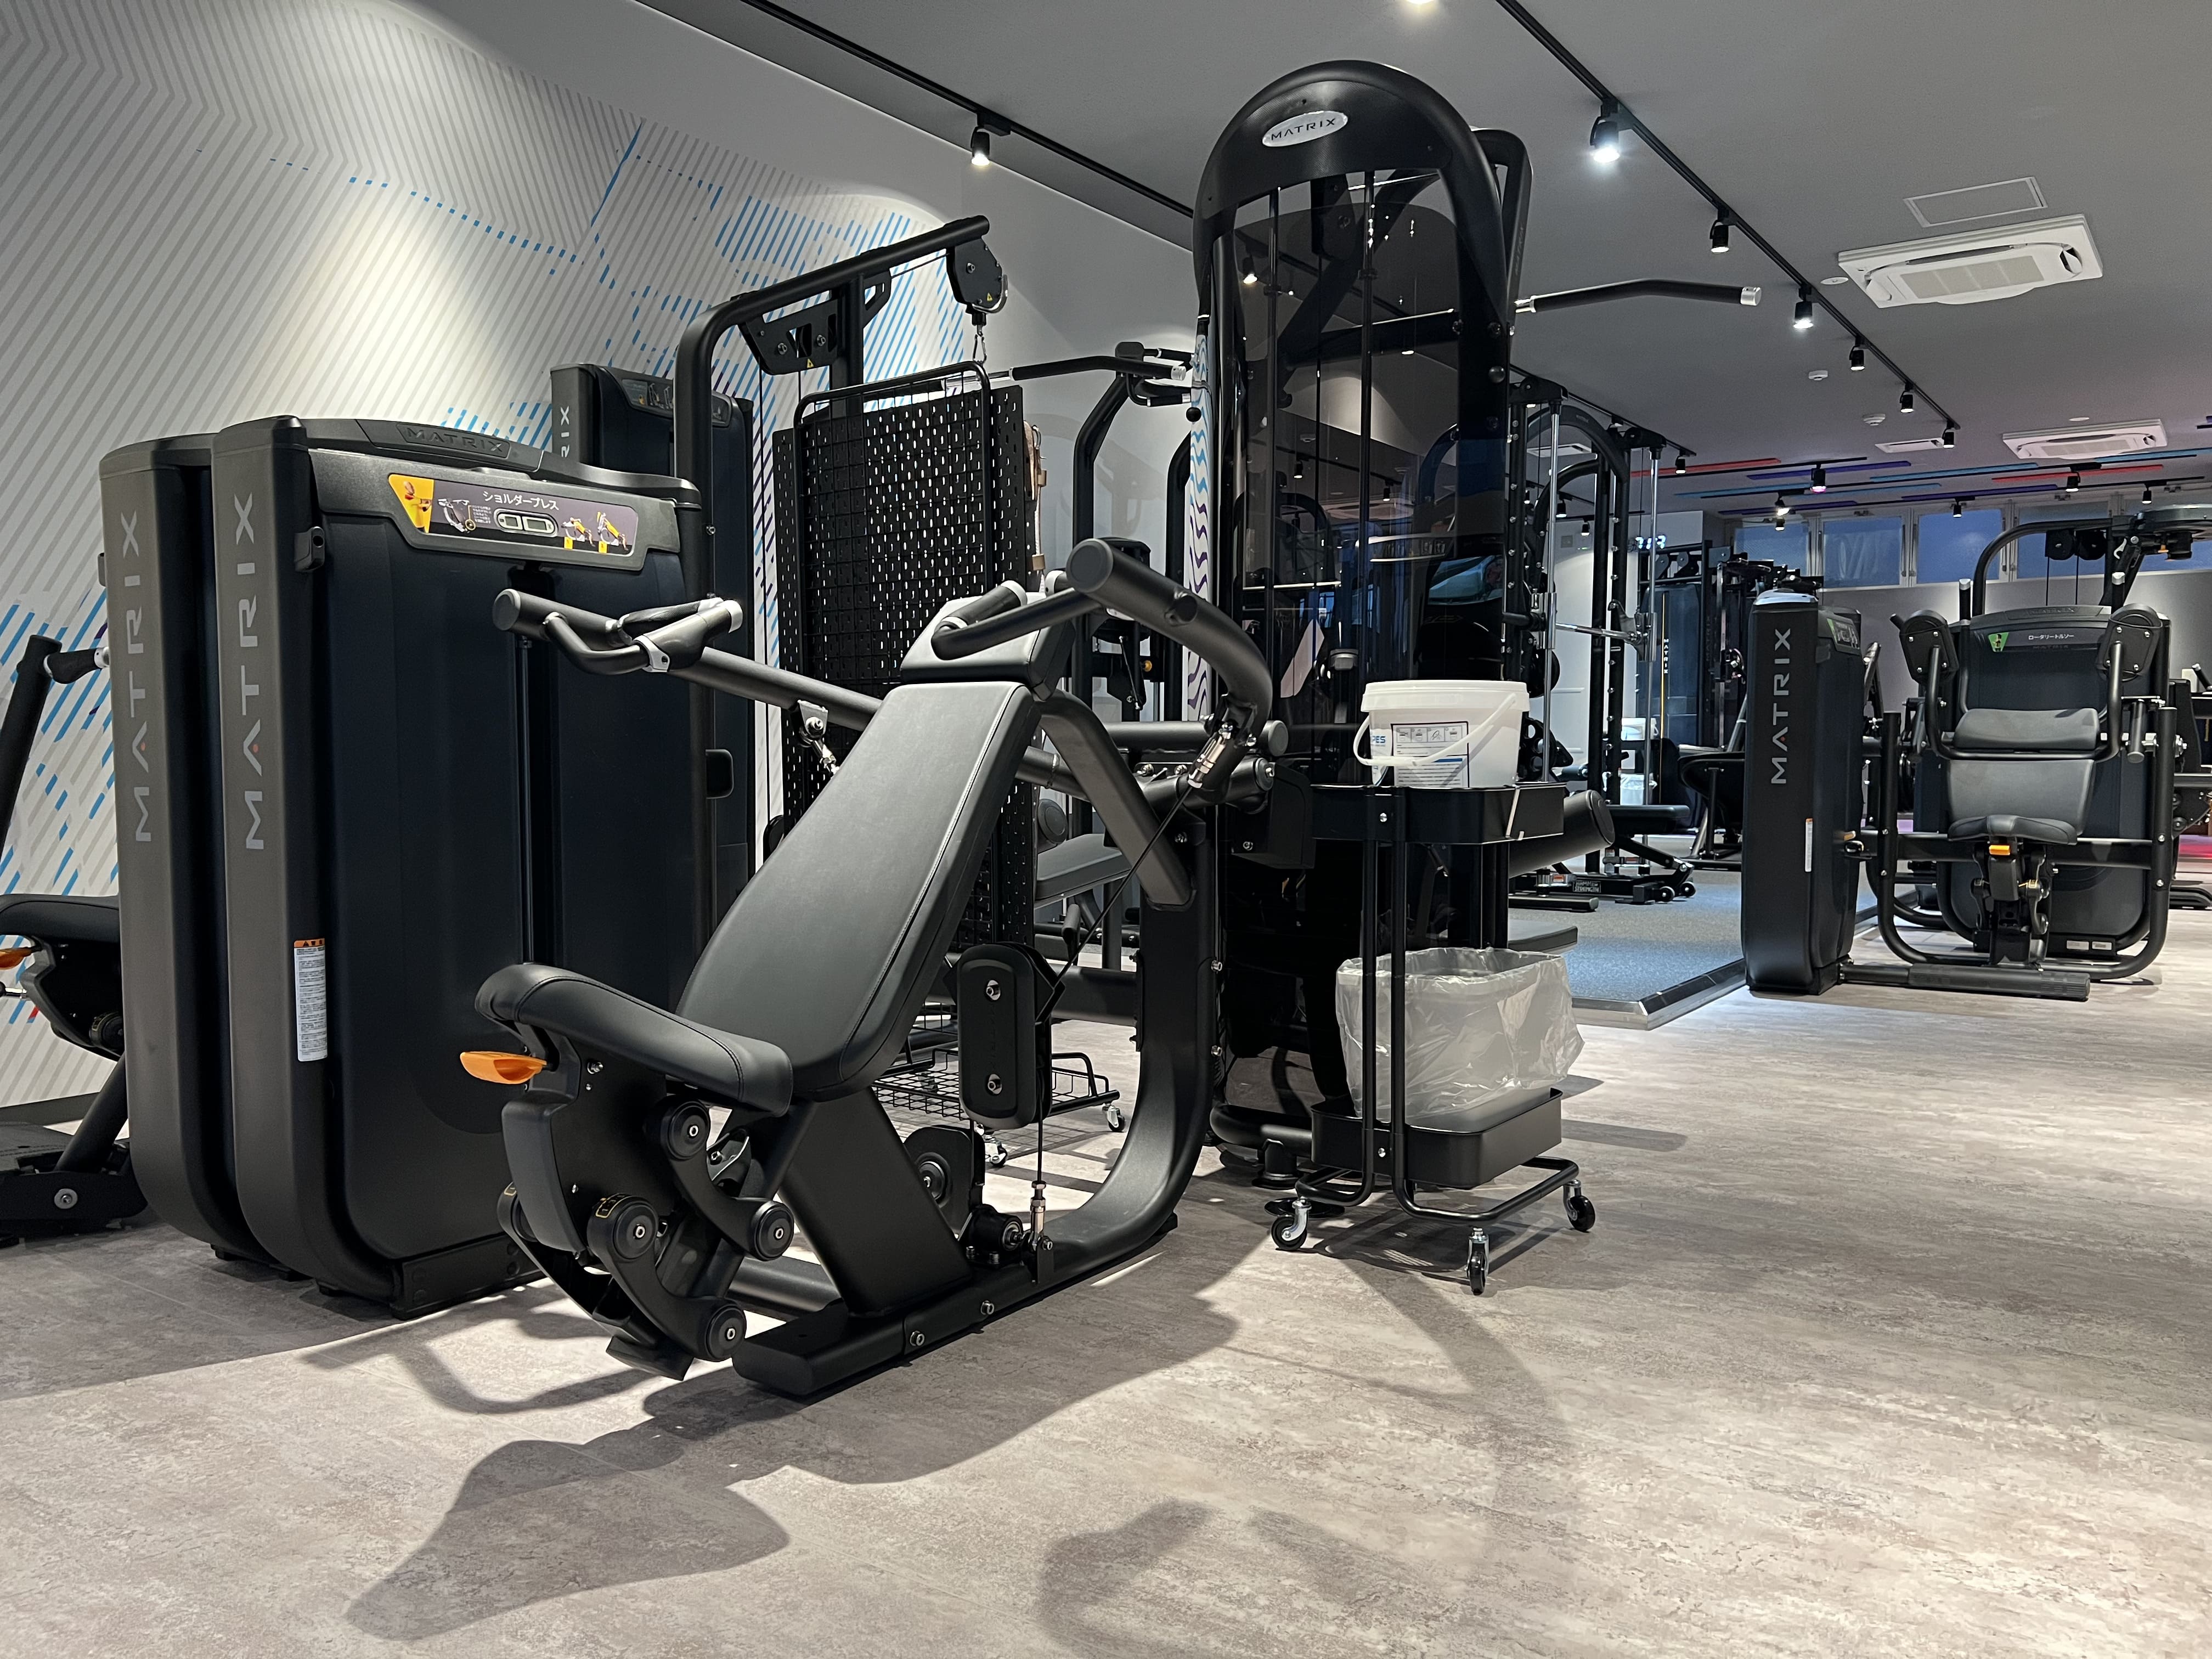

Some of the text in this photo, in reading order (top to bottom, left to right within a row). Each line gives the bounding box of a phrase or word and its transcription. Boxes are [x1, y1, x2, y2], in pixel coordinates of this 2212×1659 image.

[1271, 118, 1336, 141] MATRIX
[407, 427, 503, 453] MATRIX
[560, 405, 570, 458] RIX
[483, 491, 559, 511] ショルダープレス
[121, 510, 151, 842] MATRIX
[234, 492, 263, 850] MATRIX
[1771, 628, 1791, 784] MATRIX
